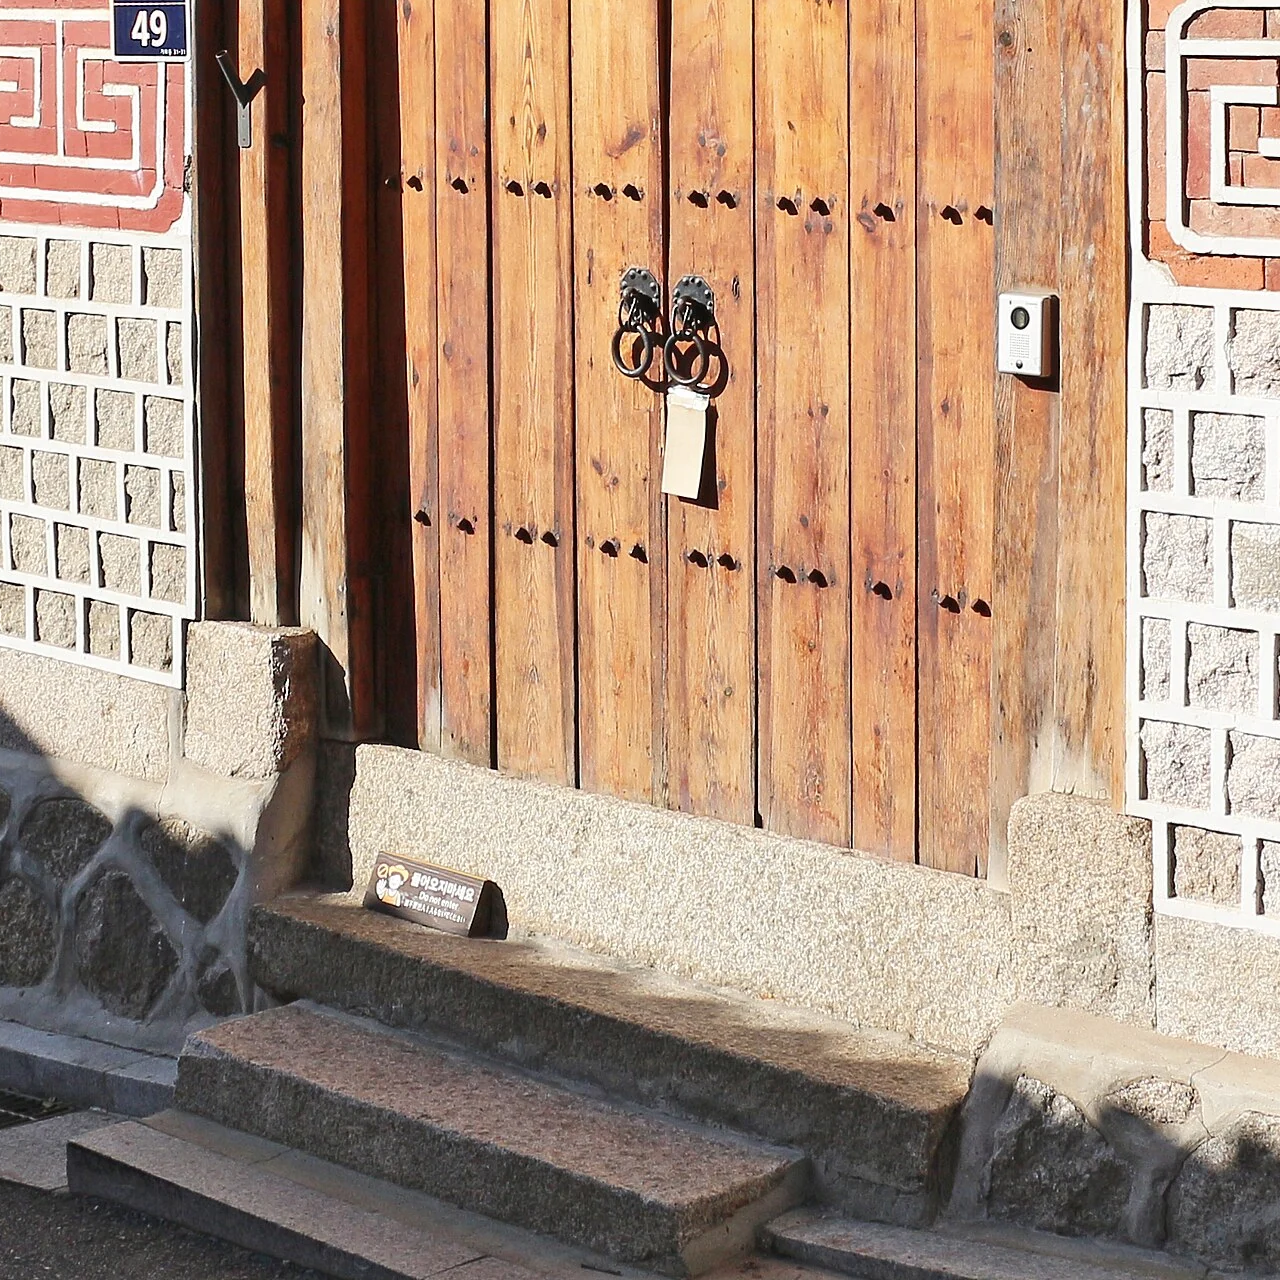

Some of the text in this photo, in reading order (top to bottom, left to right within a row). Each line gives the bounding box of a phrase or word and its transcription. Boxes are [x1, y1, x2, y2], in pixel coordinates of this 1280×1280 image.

[131, 9, 167, 47] 49
[418, 891, 429, 901] Do
[429, 894, 442, 906] not
[441, 897, 460, 911] enter
